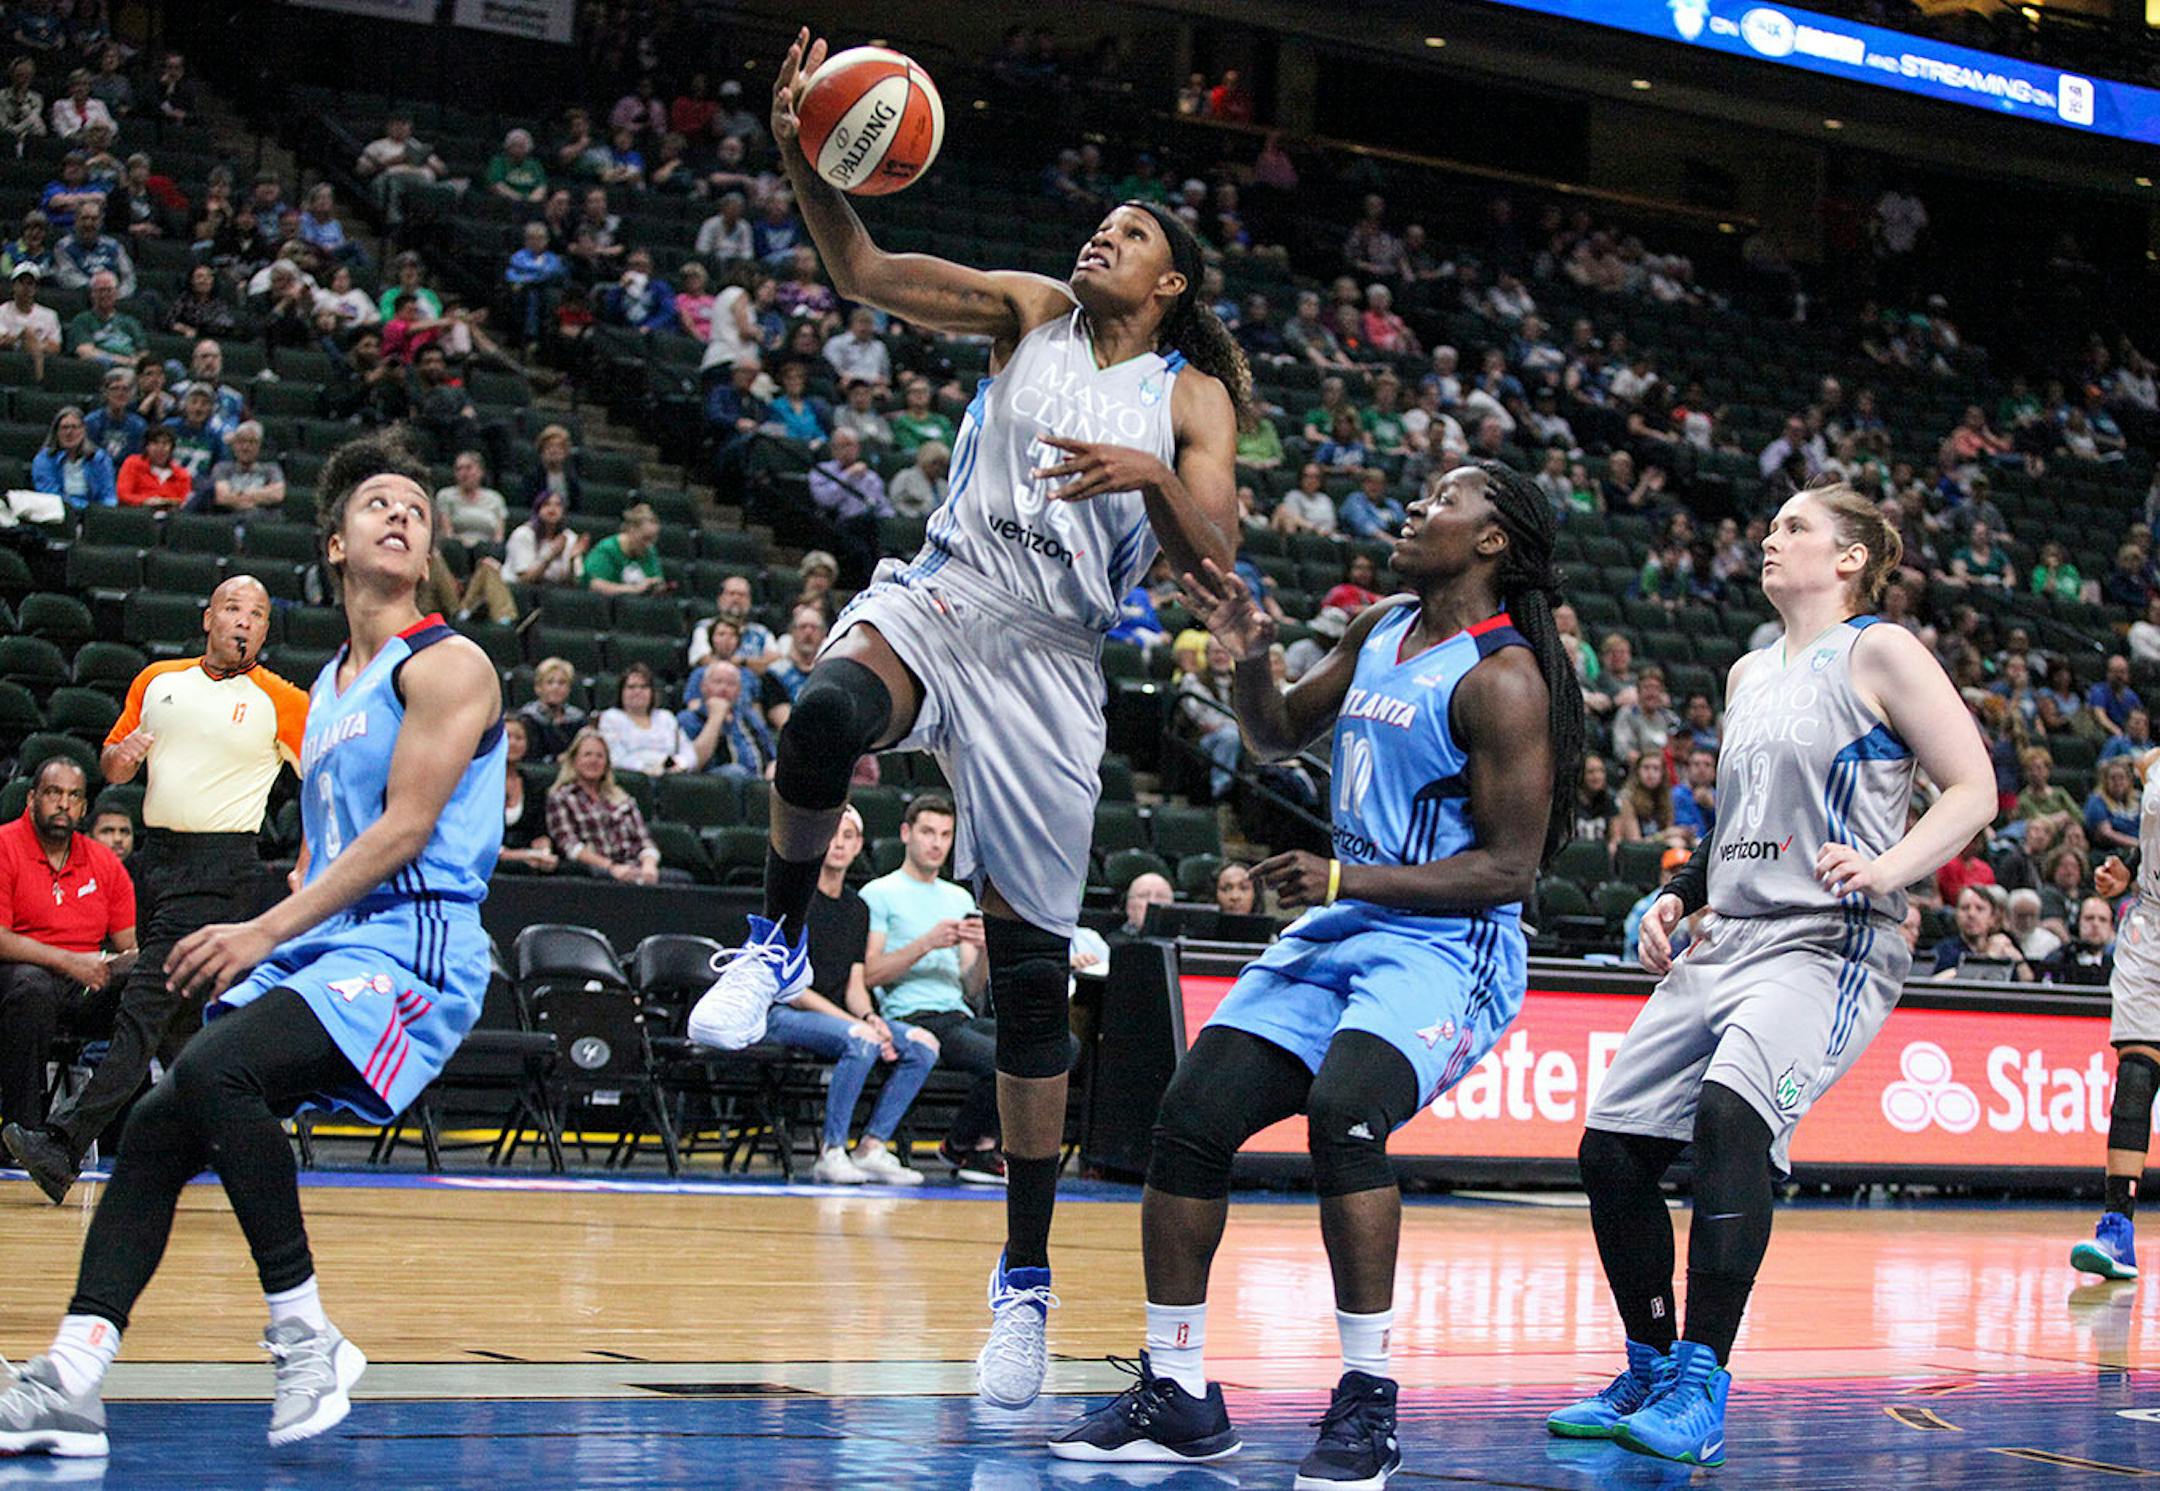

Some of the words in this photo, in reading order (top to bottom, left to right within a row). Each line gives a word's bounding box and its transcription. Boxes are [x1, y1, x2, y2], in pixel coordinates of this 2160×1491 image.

[1900, 54, 2032, 103] STREAMING
[828, 100, 897, 186] SPALDING
[1011, 386, 1122, 444] CLIN
[1038, 362, 1147, 439] MAYO
[989, 515, 1075, 568] verizon
[1338, 688, 1417, 730] TLANTA
[1340, 731, 1373, 820] 10
[1732, 750, 1772, 830] 13
[1720, 836, 1779, 861] verizon
[1987, 1045, 2115, 1134] Stat
